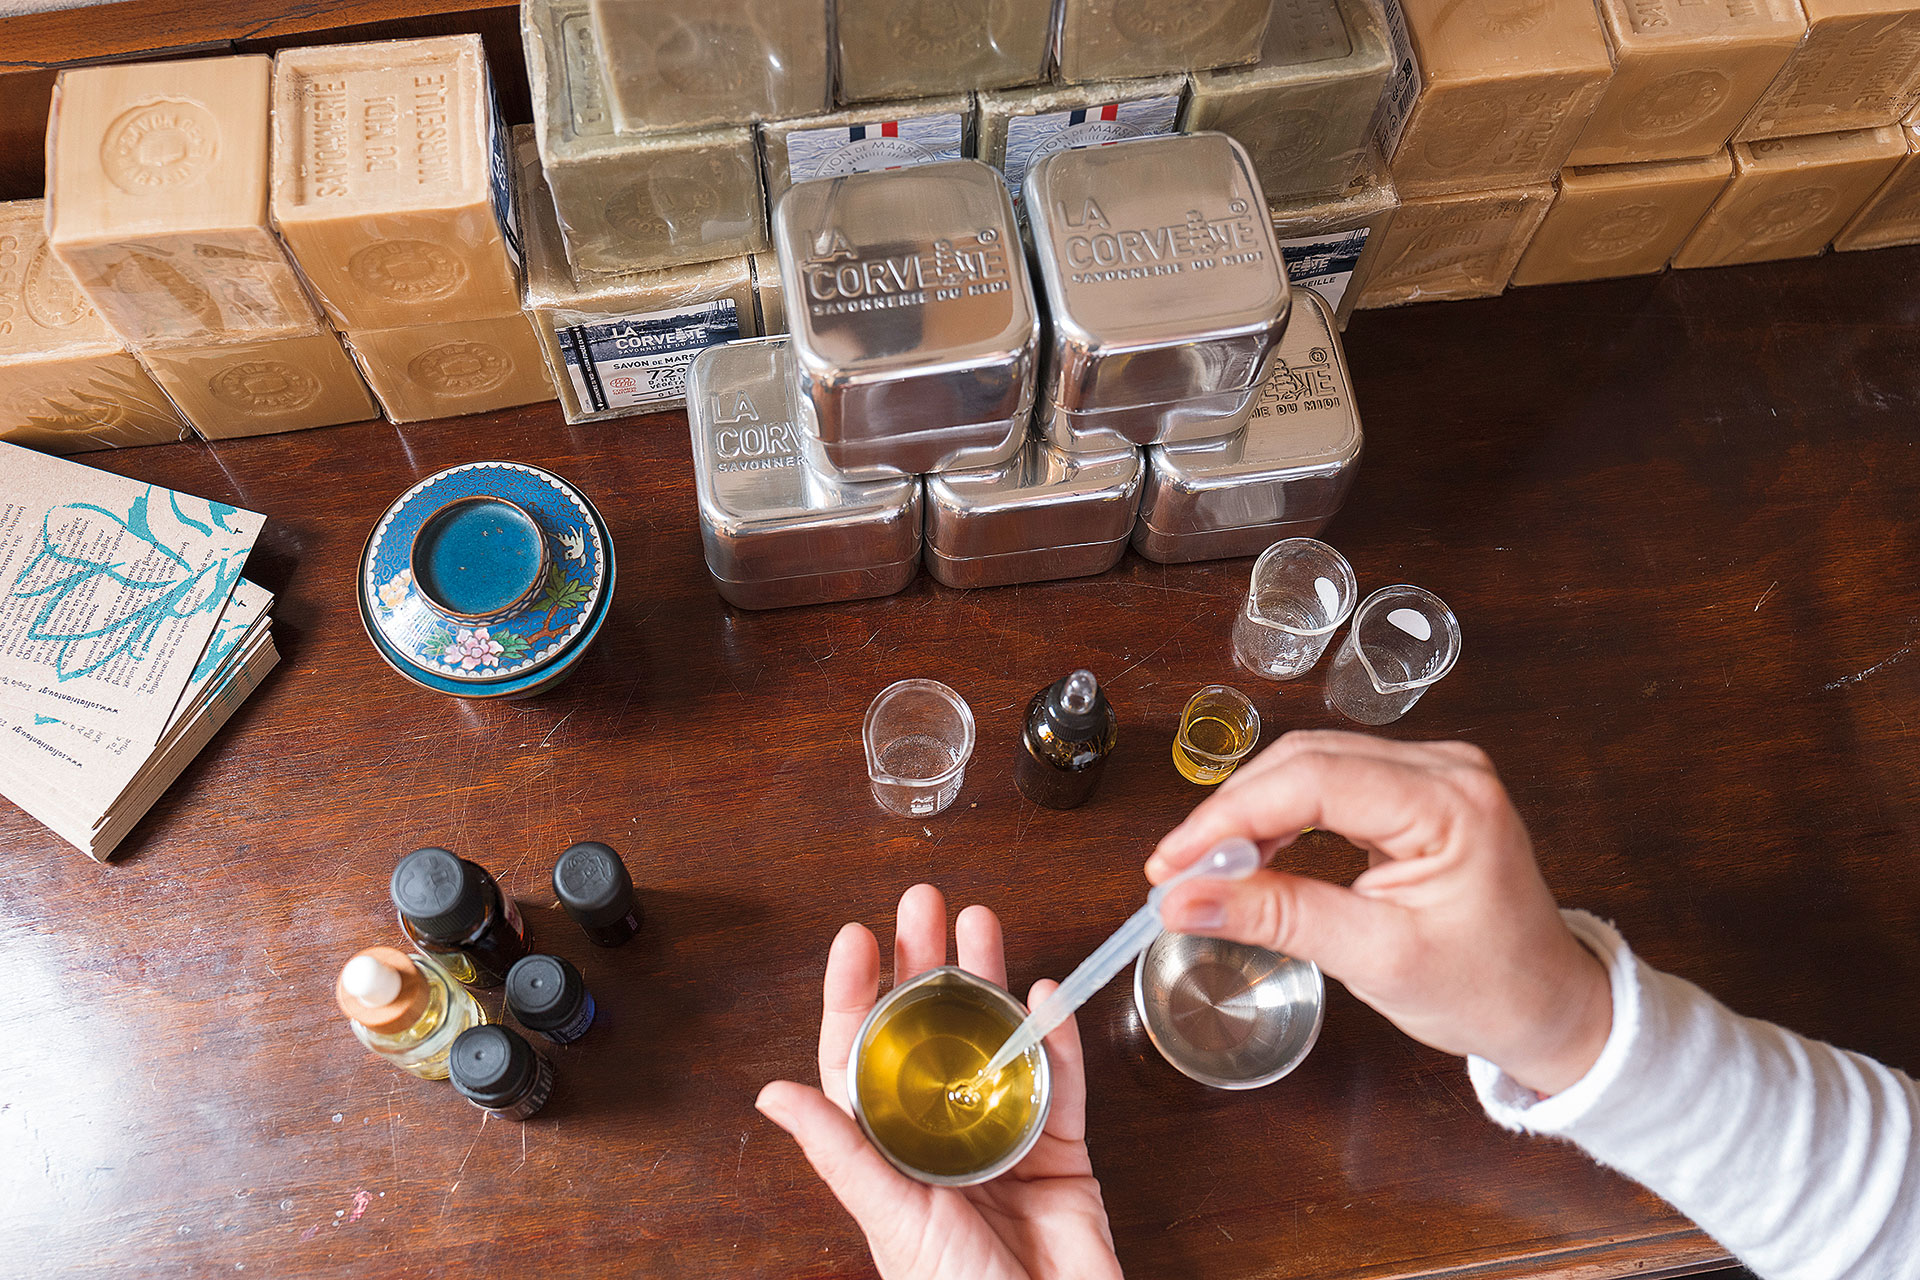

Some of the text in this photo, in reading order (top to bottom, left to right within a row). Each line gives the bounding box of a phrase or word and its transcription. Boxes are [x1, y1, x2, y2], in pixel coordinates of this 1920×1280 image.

[313, 80, 348, 198] SAVONNERIE
[363, 95, 399, 173] DU MIDI
[413, 73, 450, 185] MARSEILLE
[1056, 197, 1111, 232] LA
[807, 227, 859, 263] LA
[1071, 251, 1263, 283] SAVONNERIE DU MIDI
[812, 280, 1010, 316] SAVONNERIE DU MIDI
[611, 327, 637, 339] LA
[613, 357, 650, 370] SAVON
[709, 390, 760, 424] LA
[1277, 403, 1298, 416] DU
[1304, 397, 1341, 412] MIDI
[3, 505, 26, 536] ελληνική
[135, 566, 146, 580] από
[64, 607, 75, 621] από
[166, 648, 175, 657] και
[171, 634, 182, 646] του
